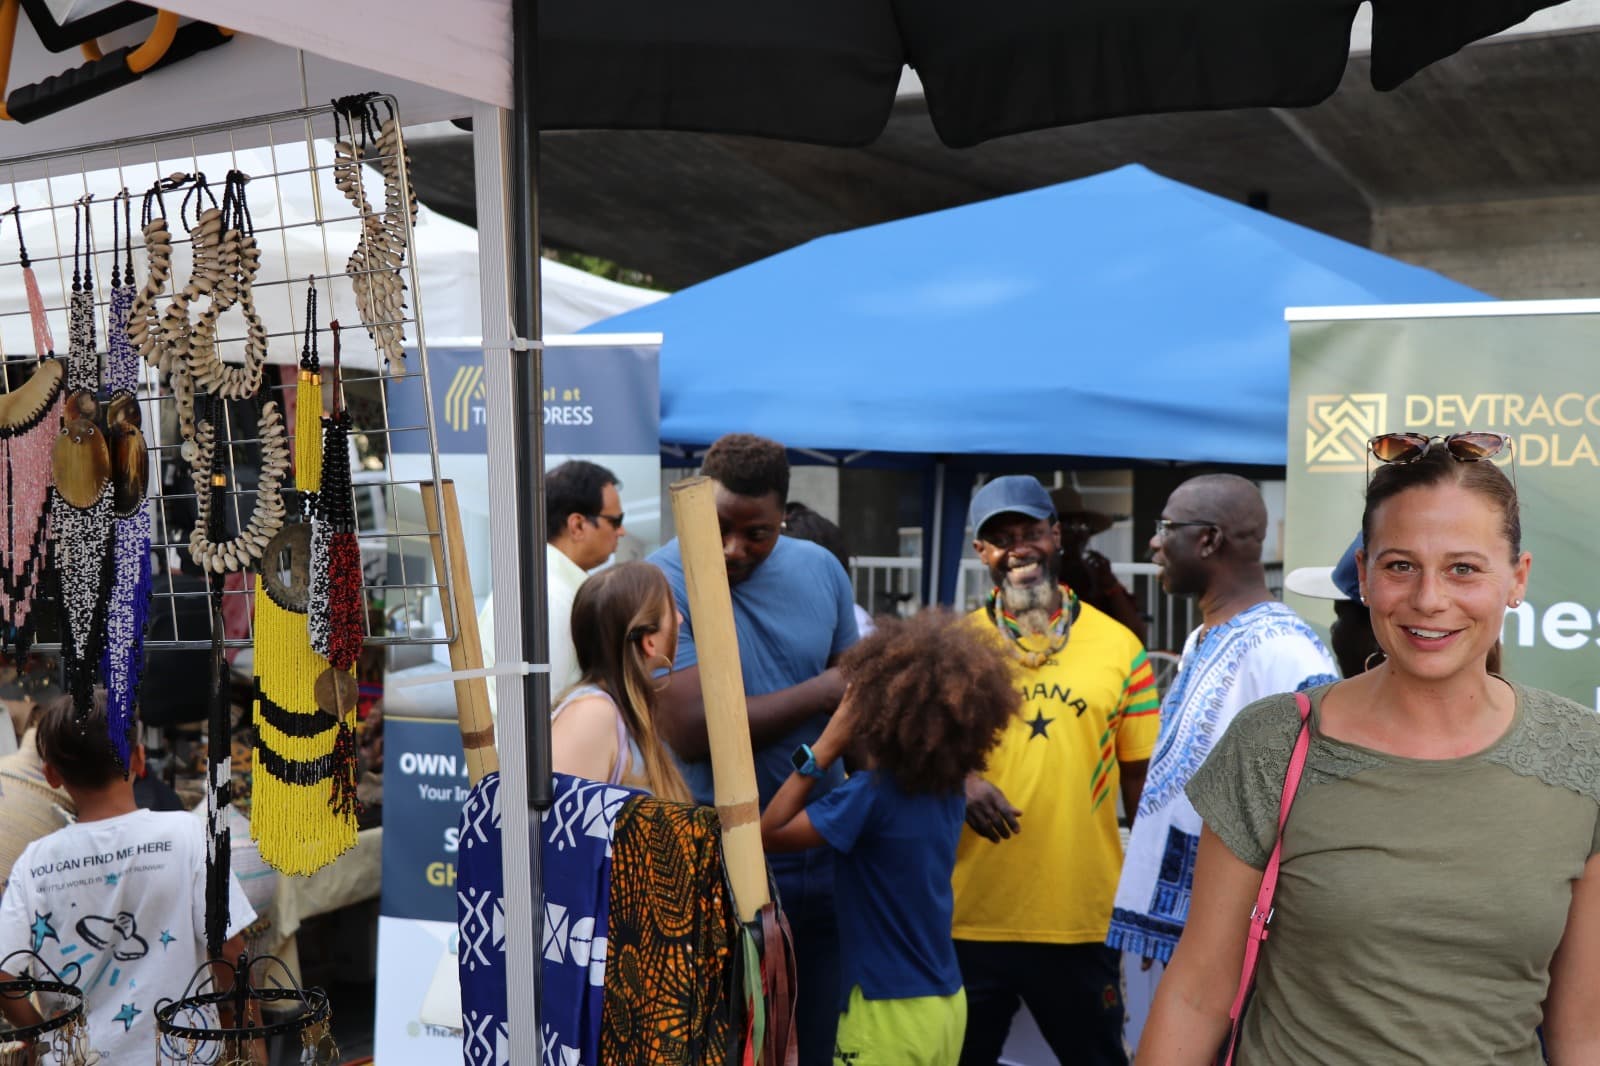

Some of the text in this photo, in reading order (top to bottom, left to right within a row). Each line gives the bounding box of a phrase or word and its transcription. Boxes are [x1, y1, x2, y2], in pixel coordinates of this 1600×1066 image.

[400, 752, 457, 776] OWN
[418, 784, 452, 801] Your
[30, 841, 173, 878] YOU CAN FIND ME HERE
